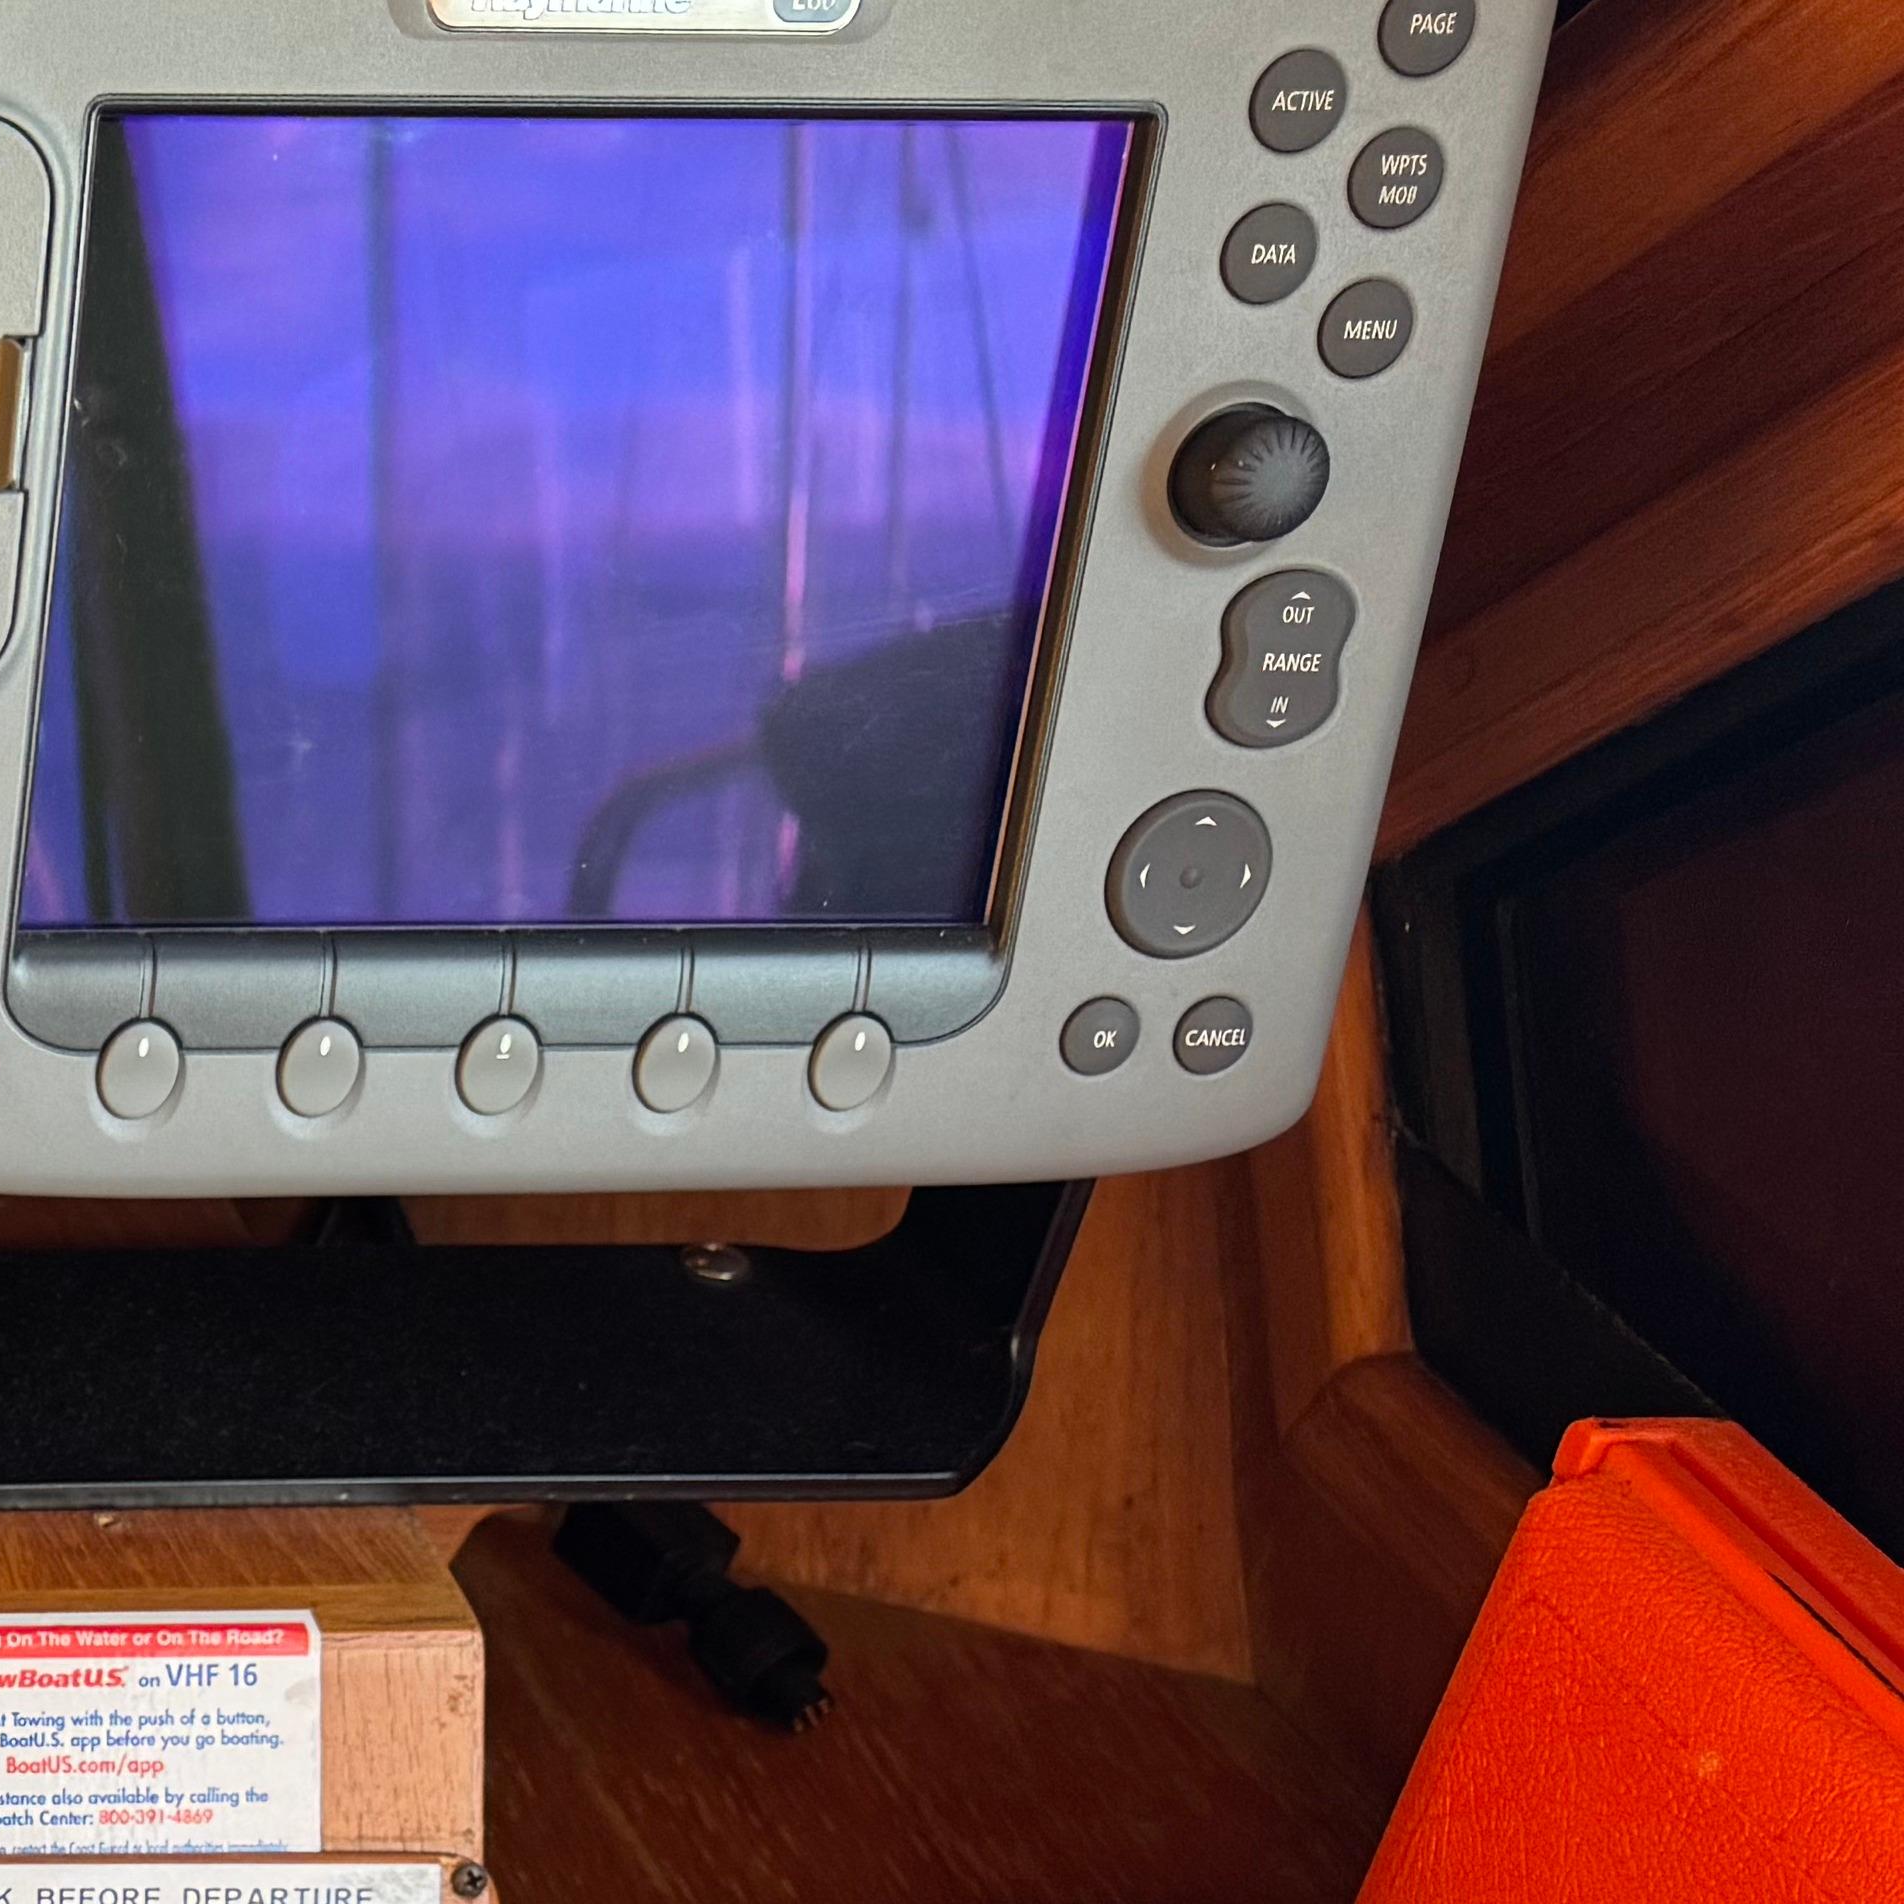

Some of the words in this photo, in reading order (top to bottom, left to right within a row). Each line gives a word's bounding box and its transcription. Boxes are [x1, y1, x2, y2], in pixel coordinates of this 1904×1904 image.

[1410, 13, 1457, 35] PAGE
[1272, 89, 1334, 112] ACTIVE
[1380, 154, 1428, 176] WPTS
[1378, 185, 1417, 205] MOB
[1251, 244, 1296, 265] DATA
[1344, 319, 1398, 341] MENU
[1282, 604, 1315, 625] OUT
[1262, 651, 1322, 674] RANGE
[1270, 696, 1289, 714] IN
[1093, 1029, 1117, 1049] OK
[1185, 1027, 1246, 1049] CANCEL
[138, 1676, 161, 1687] on
[165, 1663, 219, 1687] VHF
[229, 1663, 258, 1687] 16
[11, 1711, 65, 1730] Towing
[71, 1710, 103, 1727] with
[109, 1709, 133, 1726] the
[139, 1709, 174, 1730] push
[180, 1708, 196, 1725] of
[201, 1713, 211, 1724] a
[217, 1708, 271, 1727] button,
[6, 1754, 165, 1778] BoatUS.com/app
